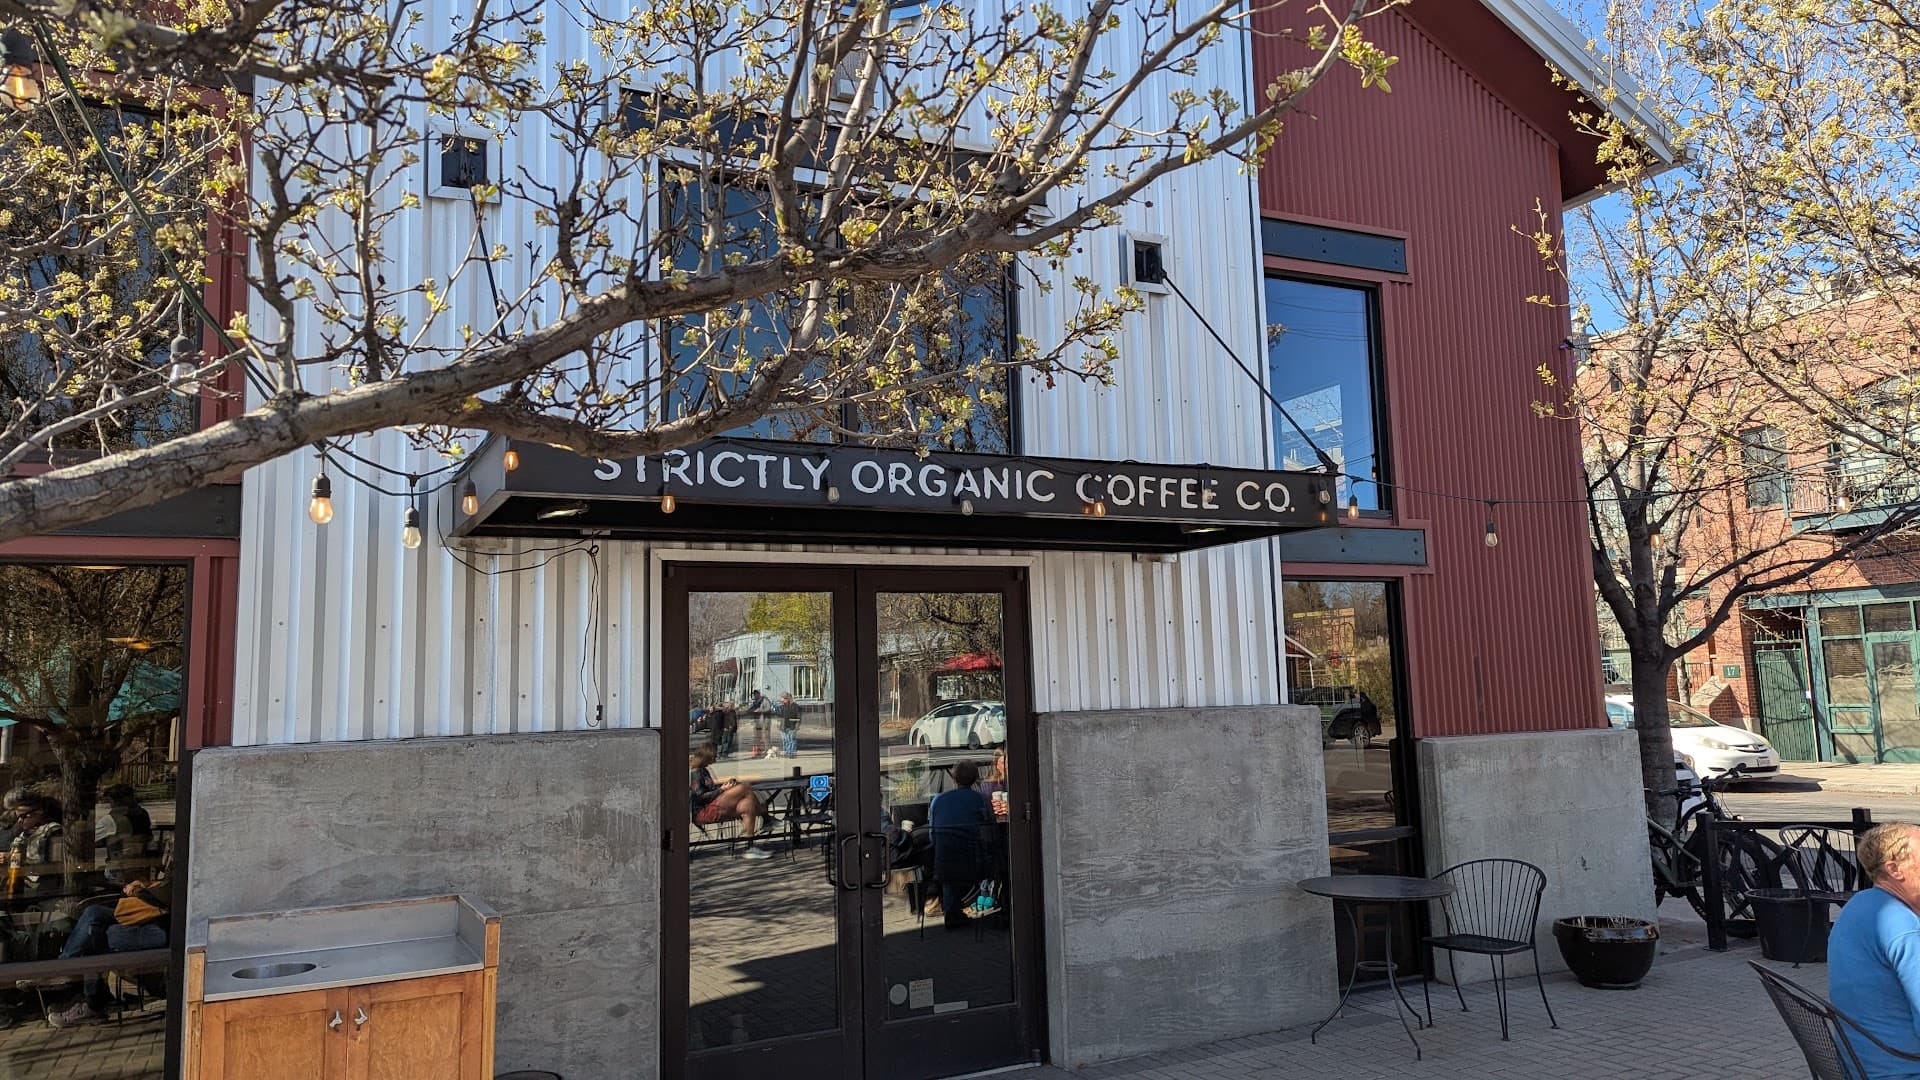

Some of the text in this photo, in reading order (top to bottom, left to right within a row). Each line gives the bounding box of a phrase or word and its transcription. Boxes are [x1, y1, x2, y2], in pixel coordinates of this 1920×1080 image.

[851, 460, 1055, 501] ORGANIC
[1075, 473, 1219, 510] COFFEE
[1236, 481, 1295, 512] CO.
[1727, 666, 1735, 676] 17
